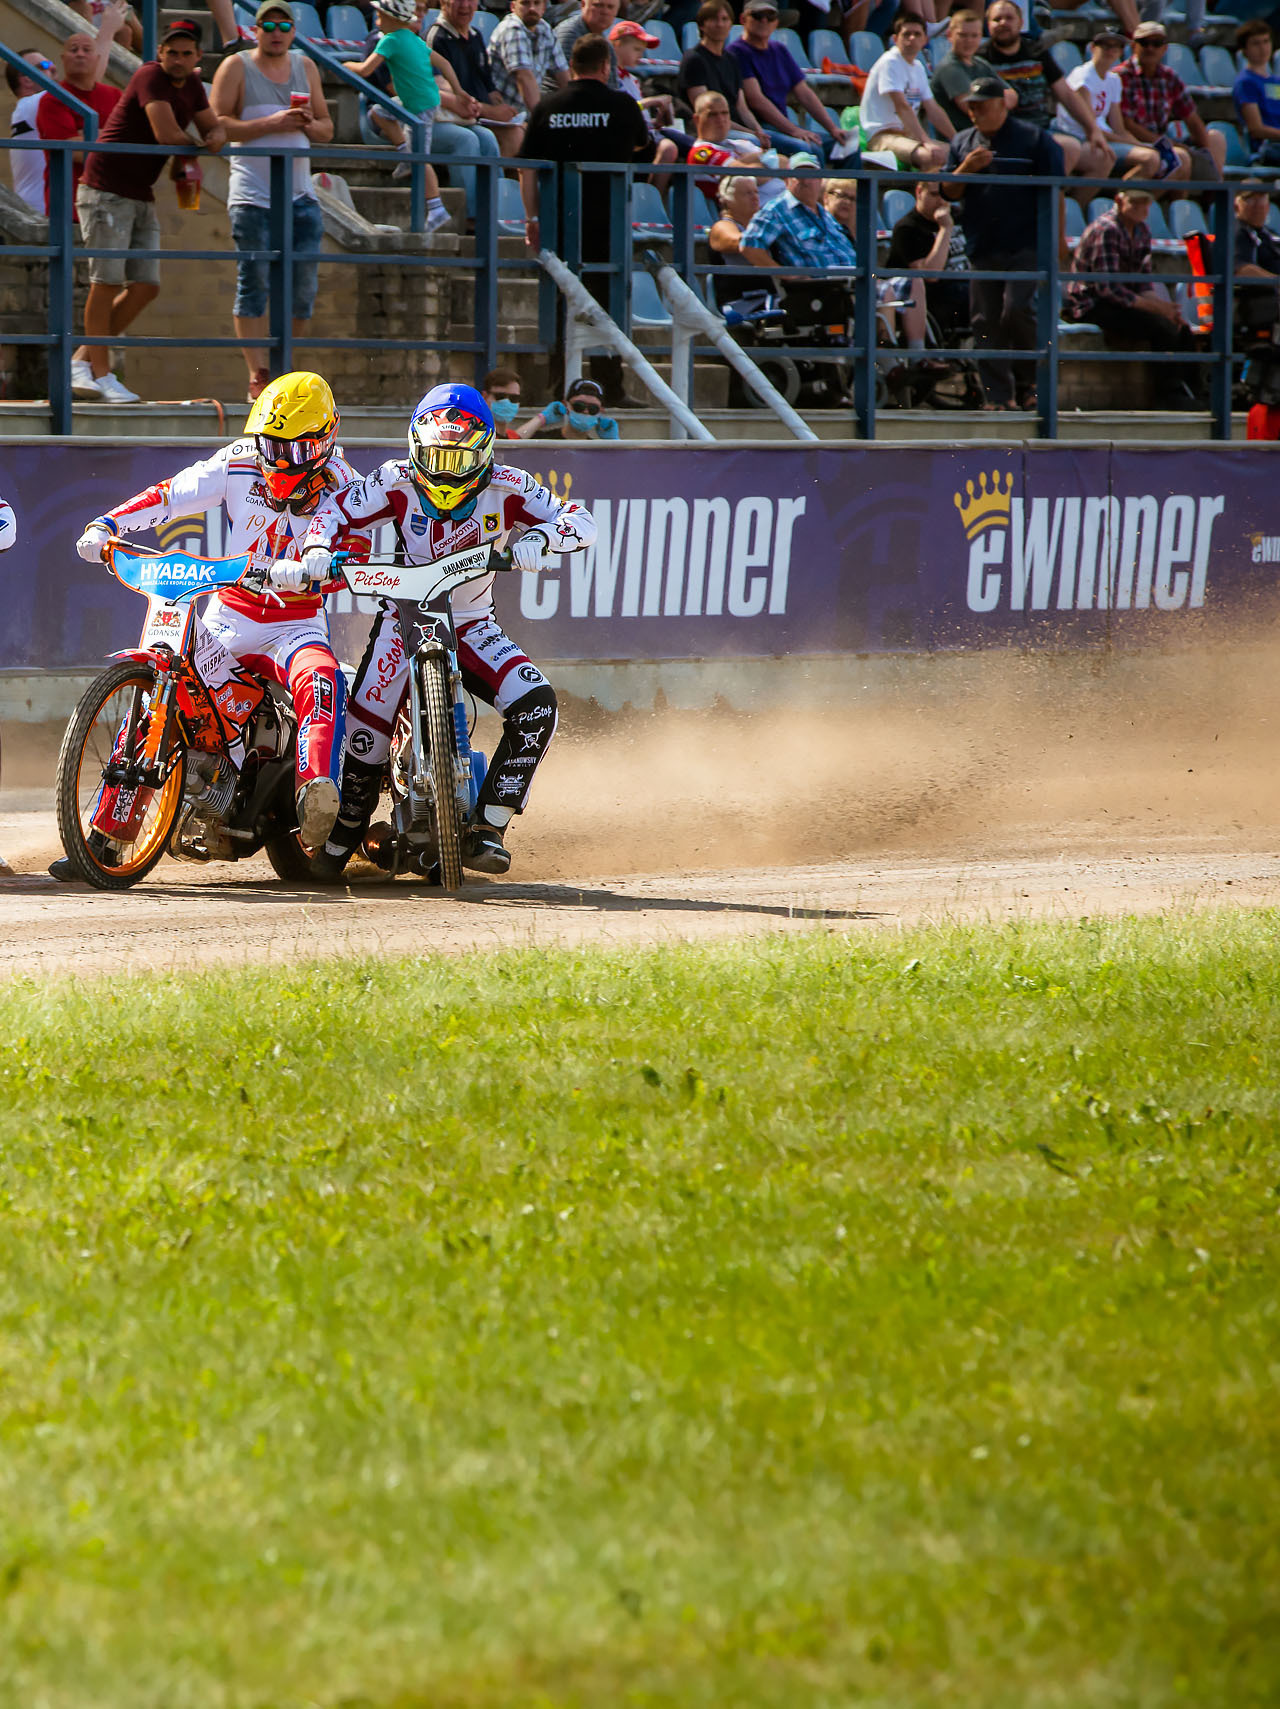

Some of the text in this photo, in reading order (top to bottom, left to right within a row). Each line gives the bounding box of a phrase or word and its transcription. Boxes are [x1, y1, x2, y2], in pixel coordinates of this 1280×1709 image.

[549, 112, 610, 128] SECURITY
[434, 521, 474, 551] LOKOMOTIV
[140, 562, 215, 582] HYABAK
[354, 570, 401, 590] PitStop
[365, 637, 404, 704] PitStop
[518, 704, 553, 724] PitStop
